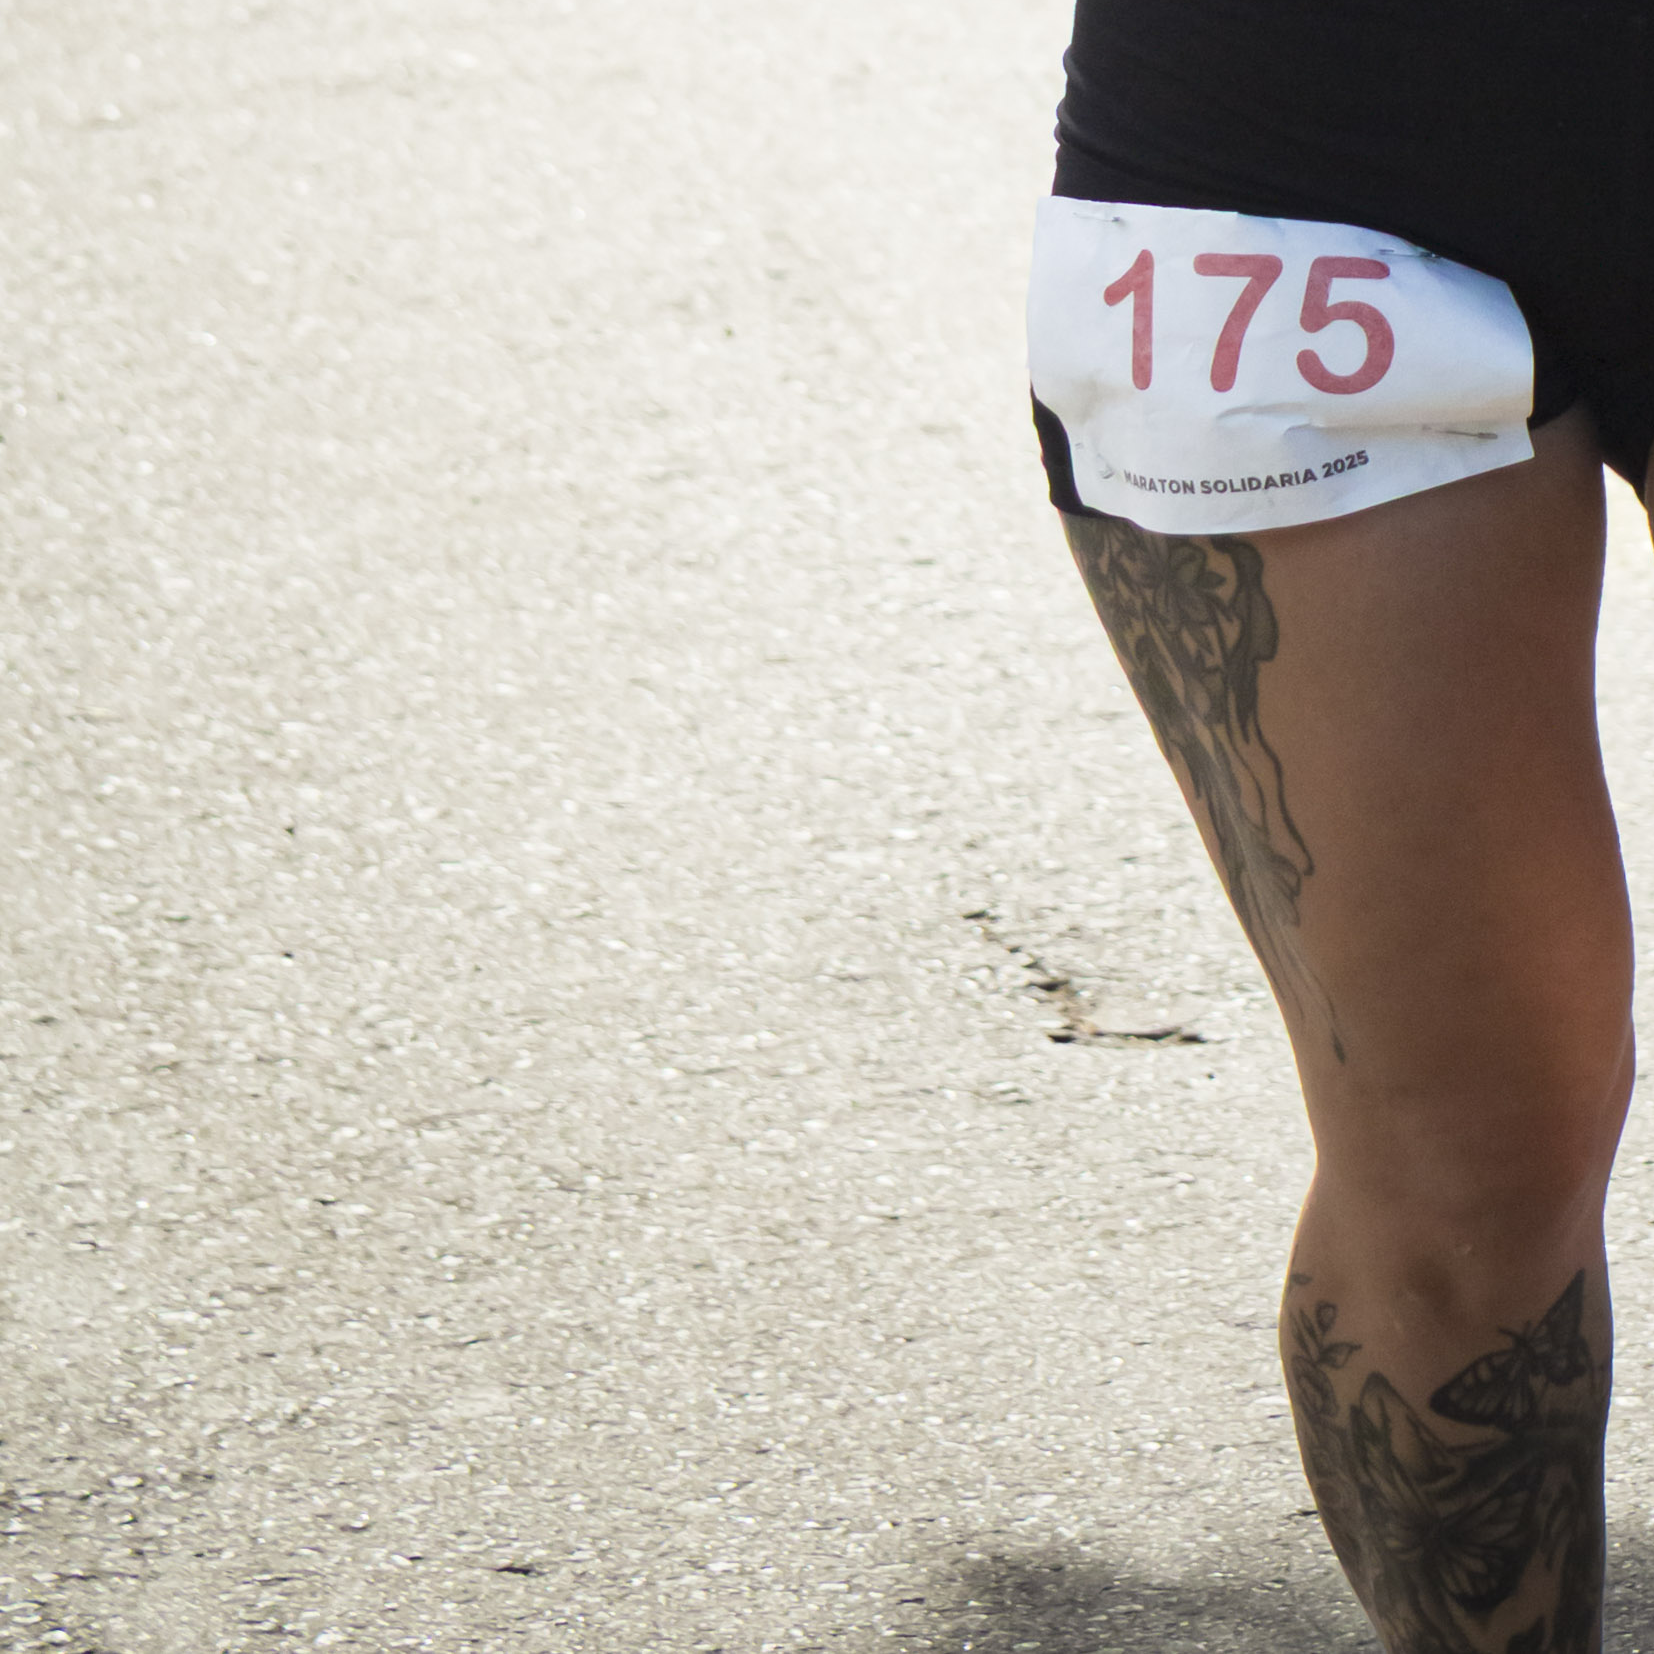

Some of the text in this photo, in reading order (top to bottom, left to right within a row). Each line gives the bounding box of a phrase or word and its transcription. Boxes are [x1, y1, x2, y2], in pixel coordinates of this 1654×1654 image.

[1103, 248, 1395, 395] 175
[1123, 449, 1370, 495] MARATON SOLIDARIA 2025
